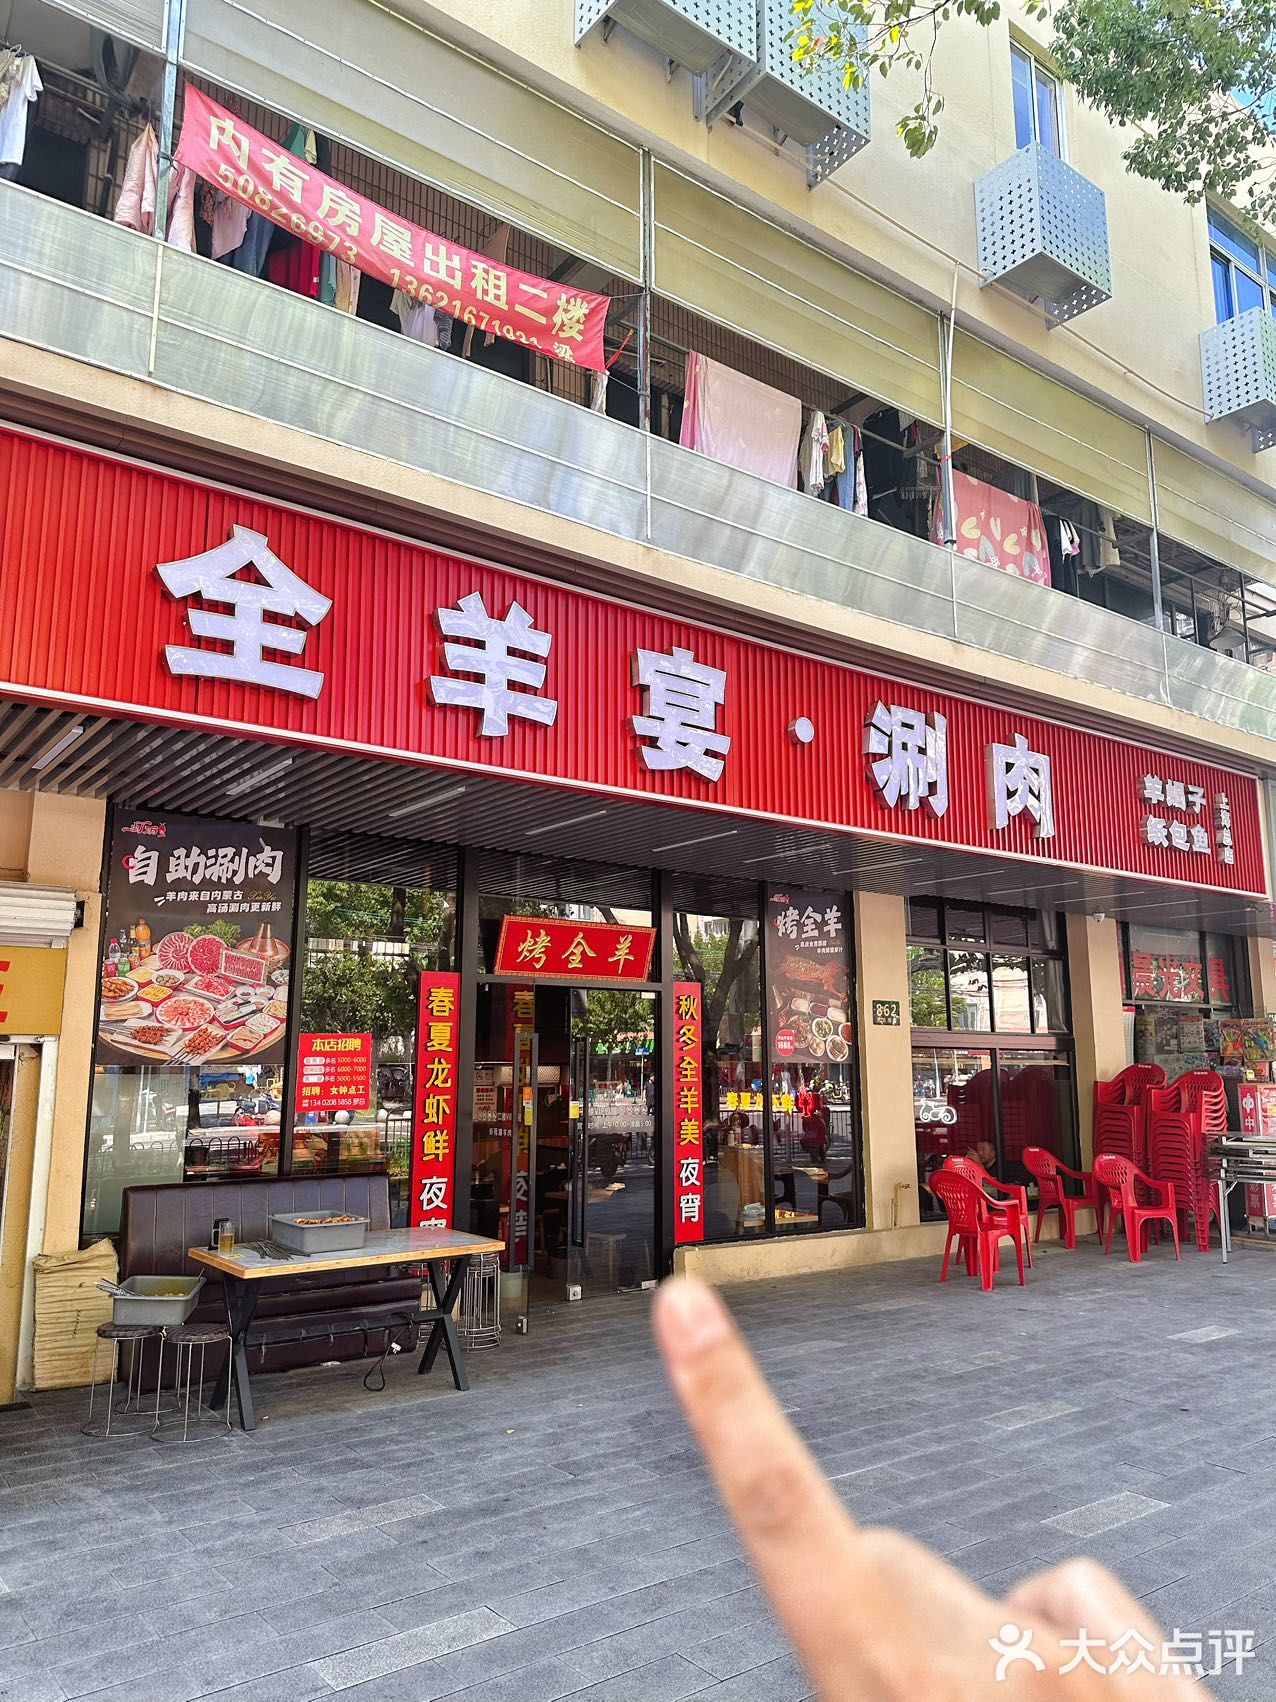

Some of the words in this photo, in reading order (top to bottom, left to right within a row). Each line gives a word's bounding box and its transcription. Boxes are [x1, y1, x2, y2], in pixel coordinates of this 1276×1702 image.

[209, 116, 590, 342] 内有房屋出租二楼
[217, 163, 358, 265] 50826973
[1144, 773, 1206, 814] 羊蝎子
[127, 837, 284, 886] 自助涮肉
[166, 890, 244, 902] 羊肉来自内蒙古
[206, 901, 282, 914] 高汤涮肉更新鲜
[776, 904, 843, 940] 烤全羊
[515, 928, 635, 975] 烤全羊
[1133, 950, 1231, 1003] 晨光文具
[876, 1003, 897, 1017] 862
[311, 1038, 362, 1051] 本店招聘
[330, 1085, 366, 1095] 女钟点工
[422, 986, 455, 1162] 春夏龙虾鲜
[678, 994, 699, 1146] 秋冬全羊美
[679, 1157, 701, 1223] 夜宵
